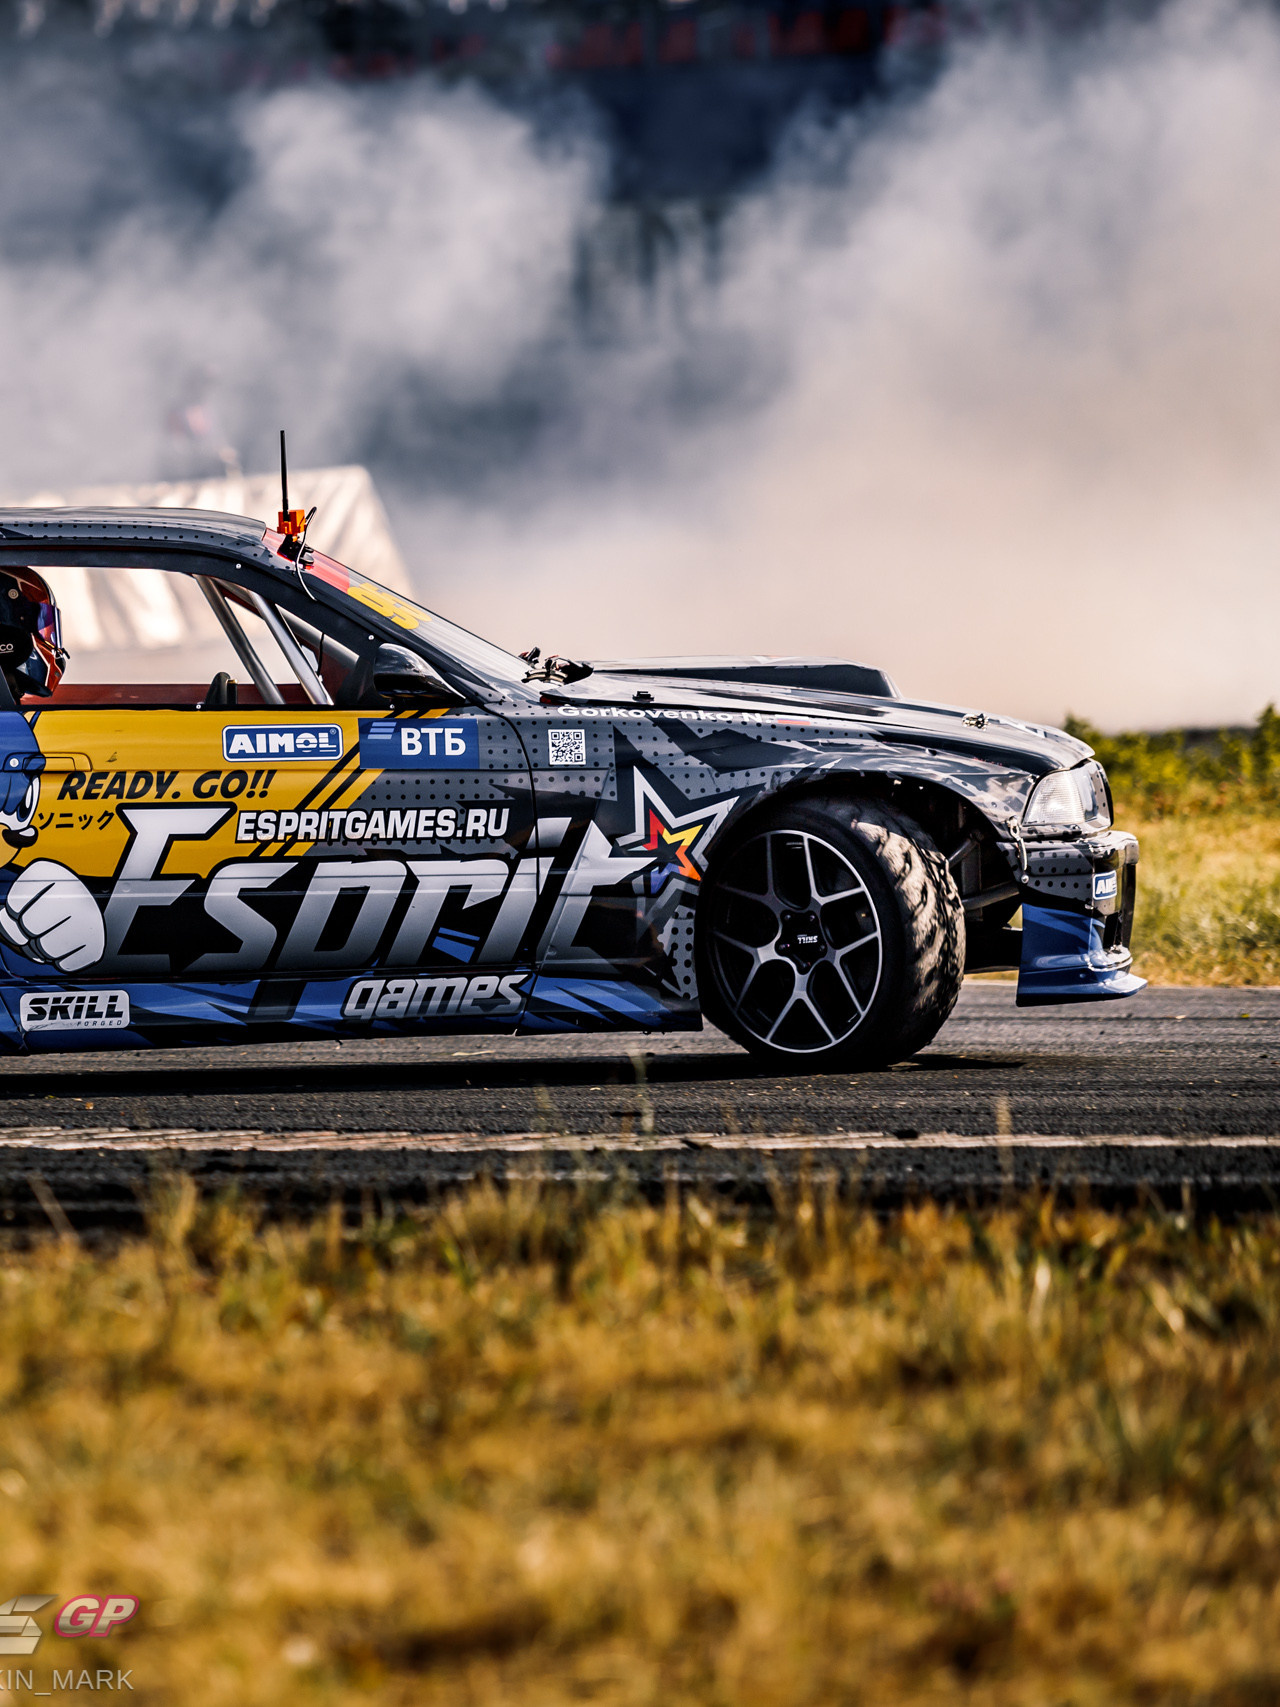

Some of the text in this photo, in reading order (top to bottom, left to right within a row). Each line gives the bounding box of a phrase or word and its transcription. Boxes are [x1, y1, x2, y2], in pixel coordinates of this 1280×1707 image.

[557, 704, 772, 723] Gorkovenko N.
[229, 732, 337, 753] AIMOL
[401, 728, 466, 756] ВТБ
[57, 769, 278, 800] READY. GO!!
[38, 809, 115, 831] ソニック
[237, 808, 510, 840] ESPRITGAMES.RU
[91, 808, 658, 978] Esprit
[27, 995, 124, 1021] SKILL
[343, 974, 528, 1019] games
